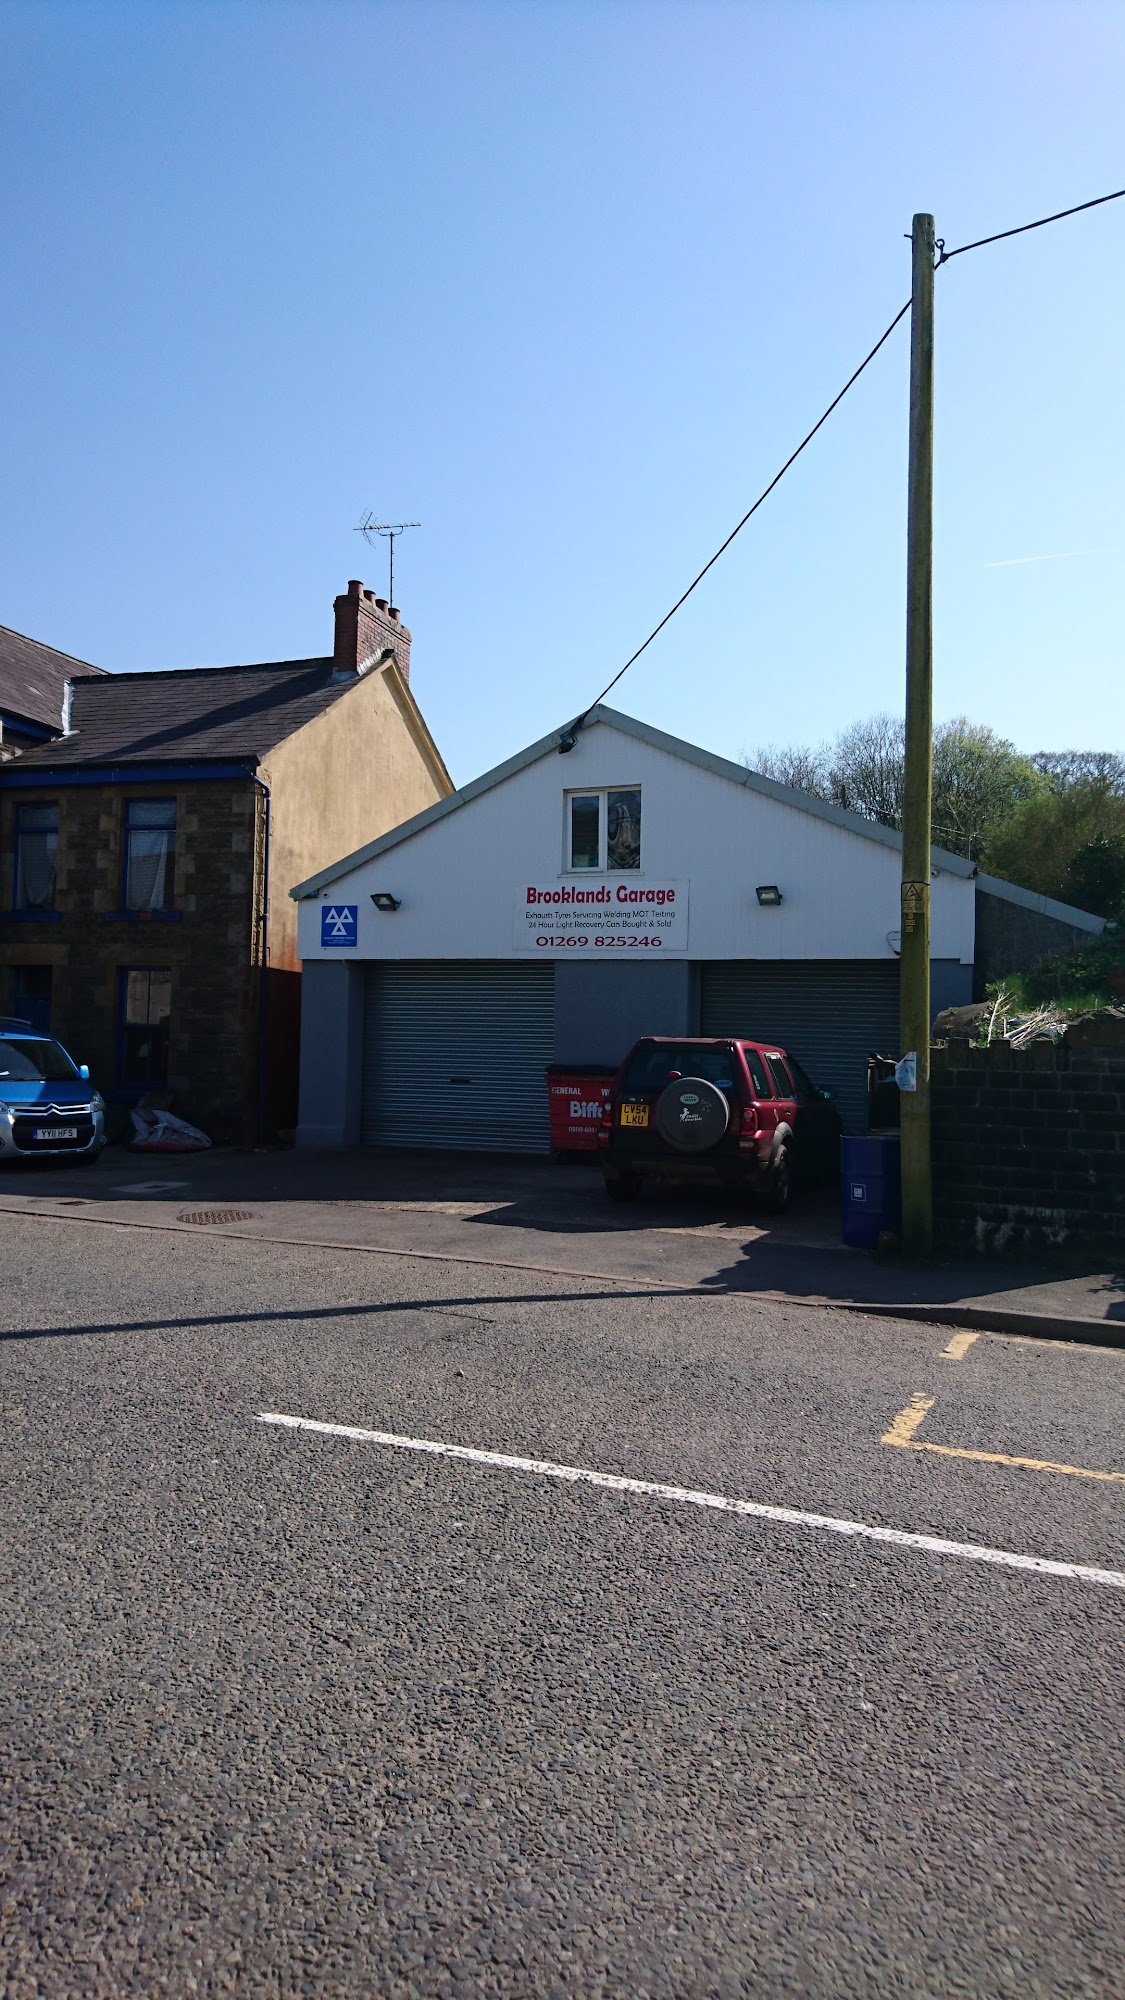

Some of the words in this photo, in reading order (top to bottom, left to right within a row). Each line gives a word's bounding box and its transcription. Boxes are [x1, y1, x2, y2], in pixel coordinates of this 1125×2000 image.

[526, 886, 611, 904] Brooklands
[616, 885, 675, 905] Garage
[525, 911, 553, 919] Exhausts
[554, 911, 571, 919] Tyres
[572, 911, 602, 919] Servicing
[603, 911, 631, 919] Welding
[632, 910, 649, 918] MOT
[651, 910, 675, 918] Testing
[556, 921, 573, 929] Light
[574, 921, 604, 929] Recovery
[606, 920, 621, 928] Cars
[622, 920, 647, 928] Bought
[656, 920, 672, 928] Sold
[536, 936, 589, 947] 01269
[594, 936, 662, 947] 825246
[551, 1087, 582, 1095] GENERAL
[624, 1104, 647, 1114] CV54
[626, 1115, 644, 1124] LKU
[58, 1129, 73, 1138] HFS
